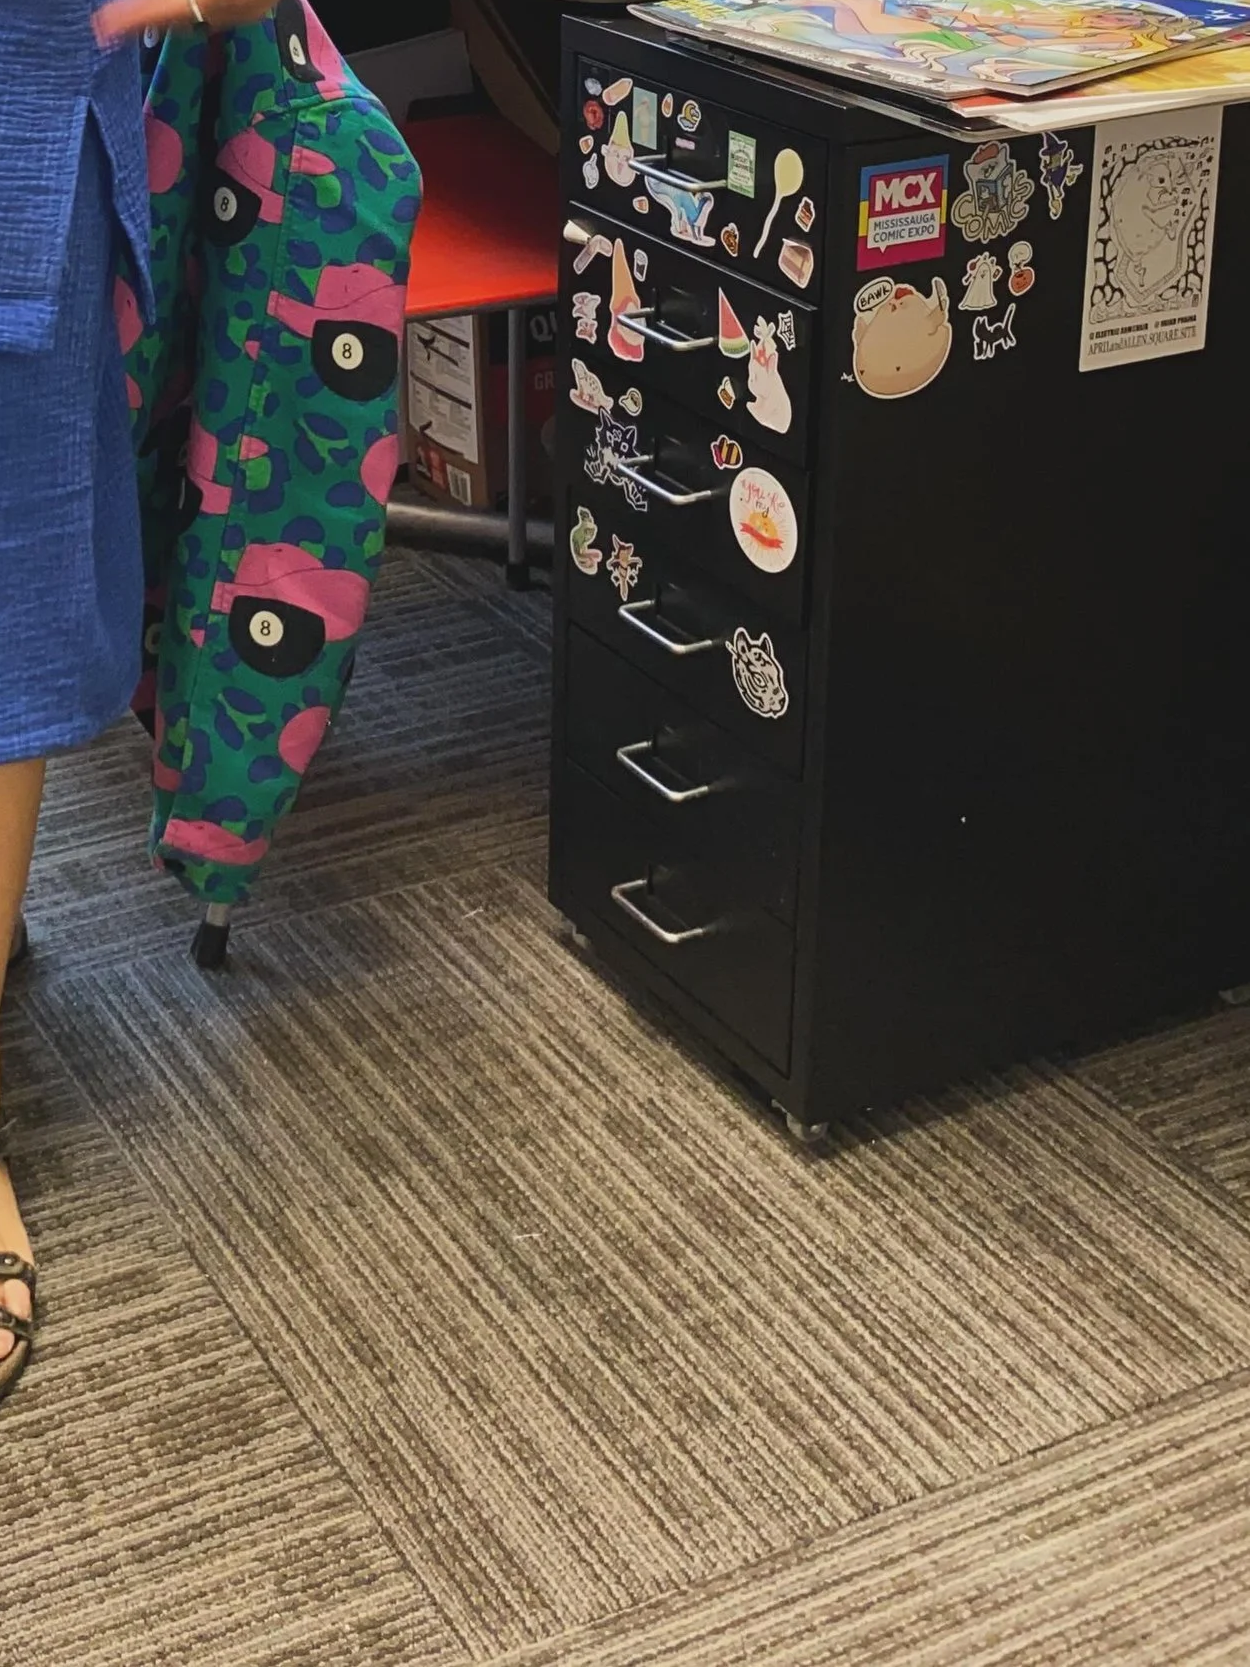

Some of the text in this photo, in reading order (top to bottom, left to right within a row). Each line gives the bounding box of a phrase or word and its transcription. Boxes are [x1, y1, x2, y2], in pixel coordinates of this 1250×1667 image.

[874, 172, 937, 212] MCX
[220, 196, 229, 212] 8
[873, 213, 936, 231] MISSISSAUGA
[873, 224, 935, 243] COMIC EXPO
[860, 285, 890, 308] BAWK
[342, 343, 352, 359] 8
[534, 370, 557, 391] GR
[260, 620, 270, 636] 8
